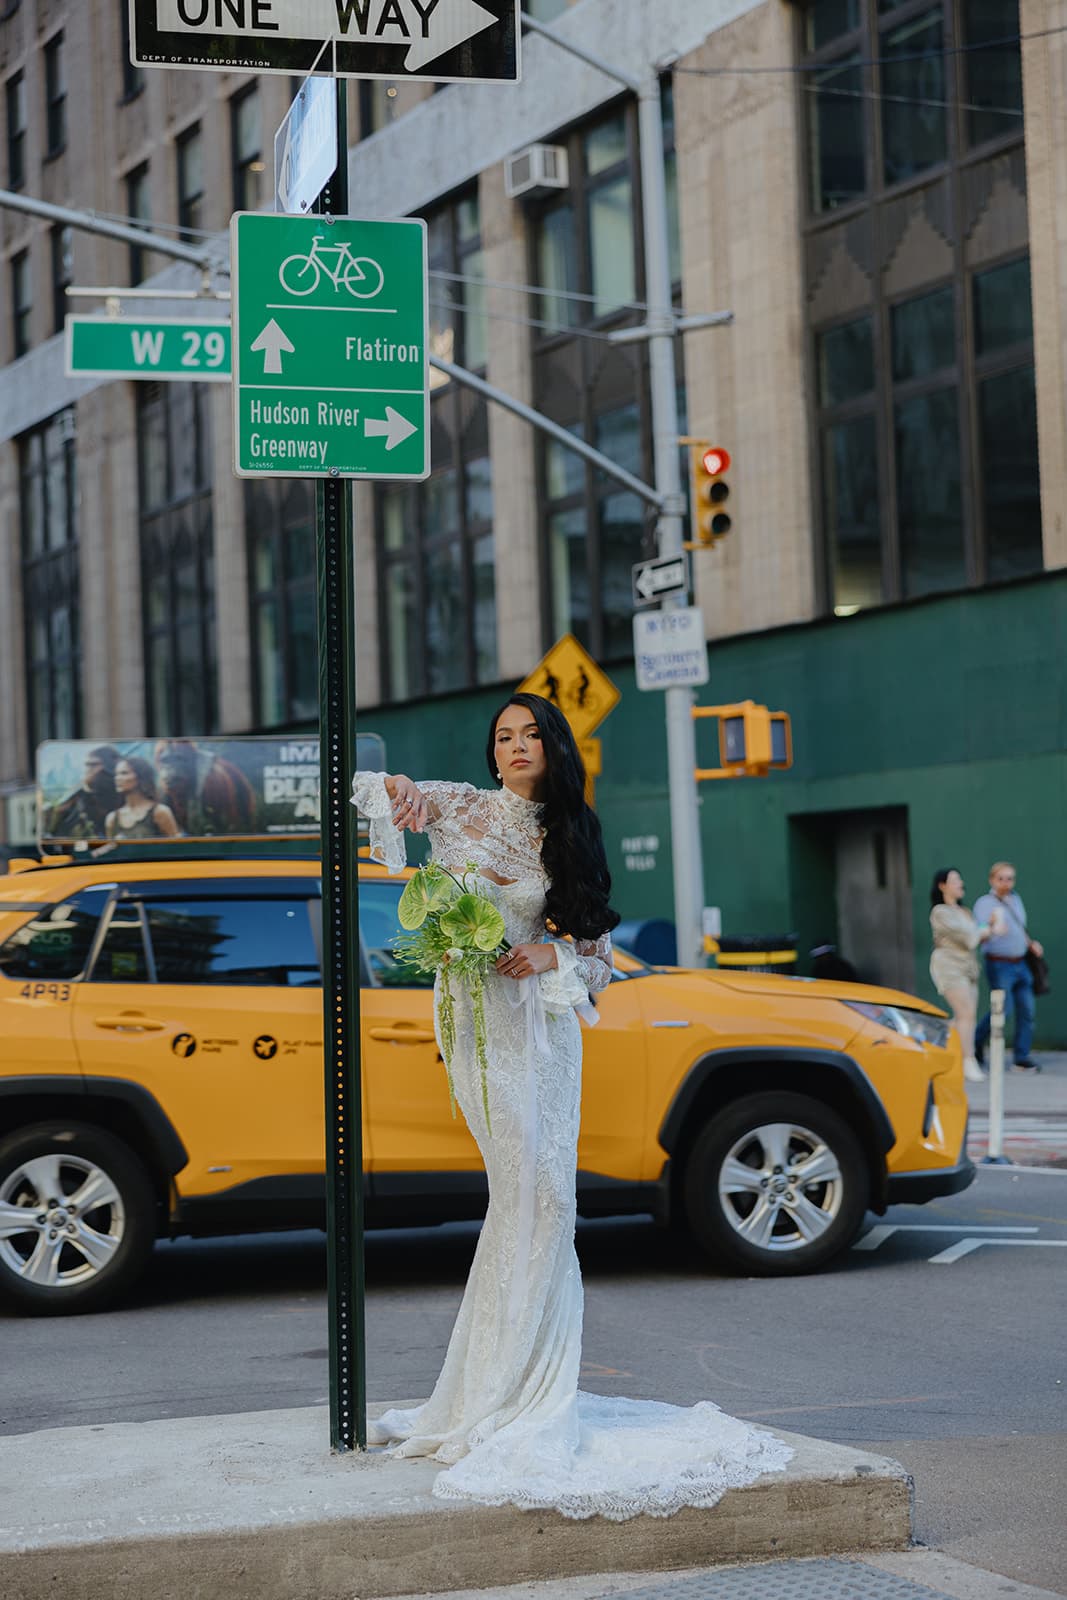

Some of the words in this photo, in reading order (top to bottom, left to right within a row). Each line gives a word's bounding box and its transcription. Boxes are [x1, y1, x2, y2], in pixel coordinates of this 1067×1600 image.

[177, 0, 280, 31] ONE
[335, 0, 440, 39] WAY
[142, 54, 166, 62] DEPT
[187, 57, 271, 68] TRANSPORTATION
[131, 330, 165, 366] W
[181, 331, 226, 368] 29
[346, 337, 419, 363] Flatiron
[250, 400, 310, 425] Hudson
[317, 402, 360, 427] River
[250, 433, 328, 465] Greenway
